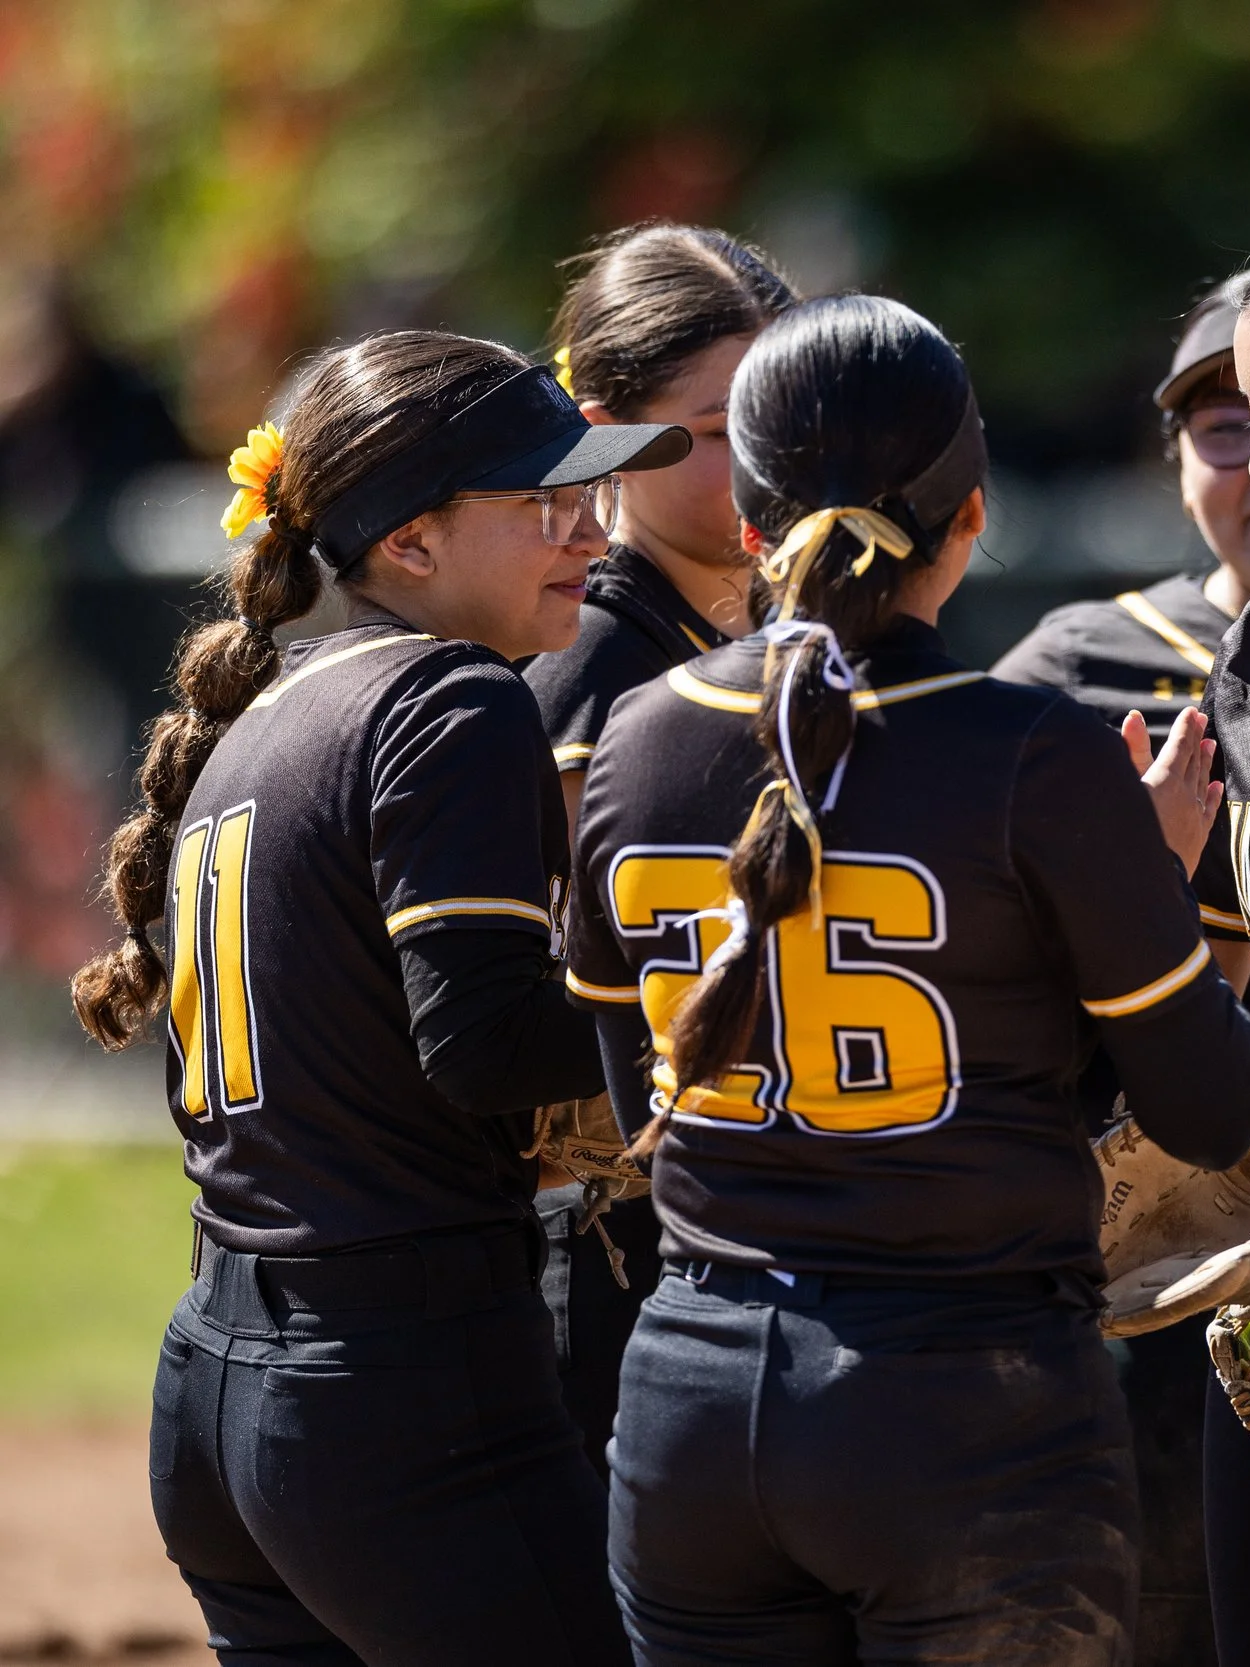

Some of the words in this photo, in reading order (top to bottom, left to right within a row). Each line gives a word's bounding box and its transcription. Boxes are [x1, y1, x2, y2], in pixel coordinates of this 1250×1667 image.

[167, 799, 264, 1124] 11
[608, 844, 962, 1139] 26
[1100, 1181, 1134, 1225] Wil
